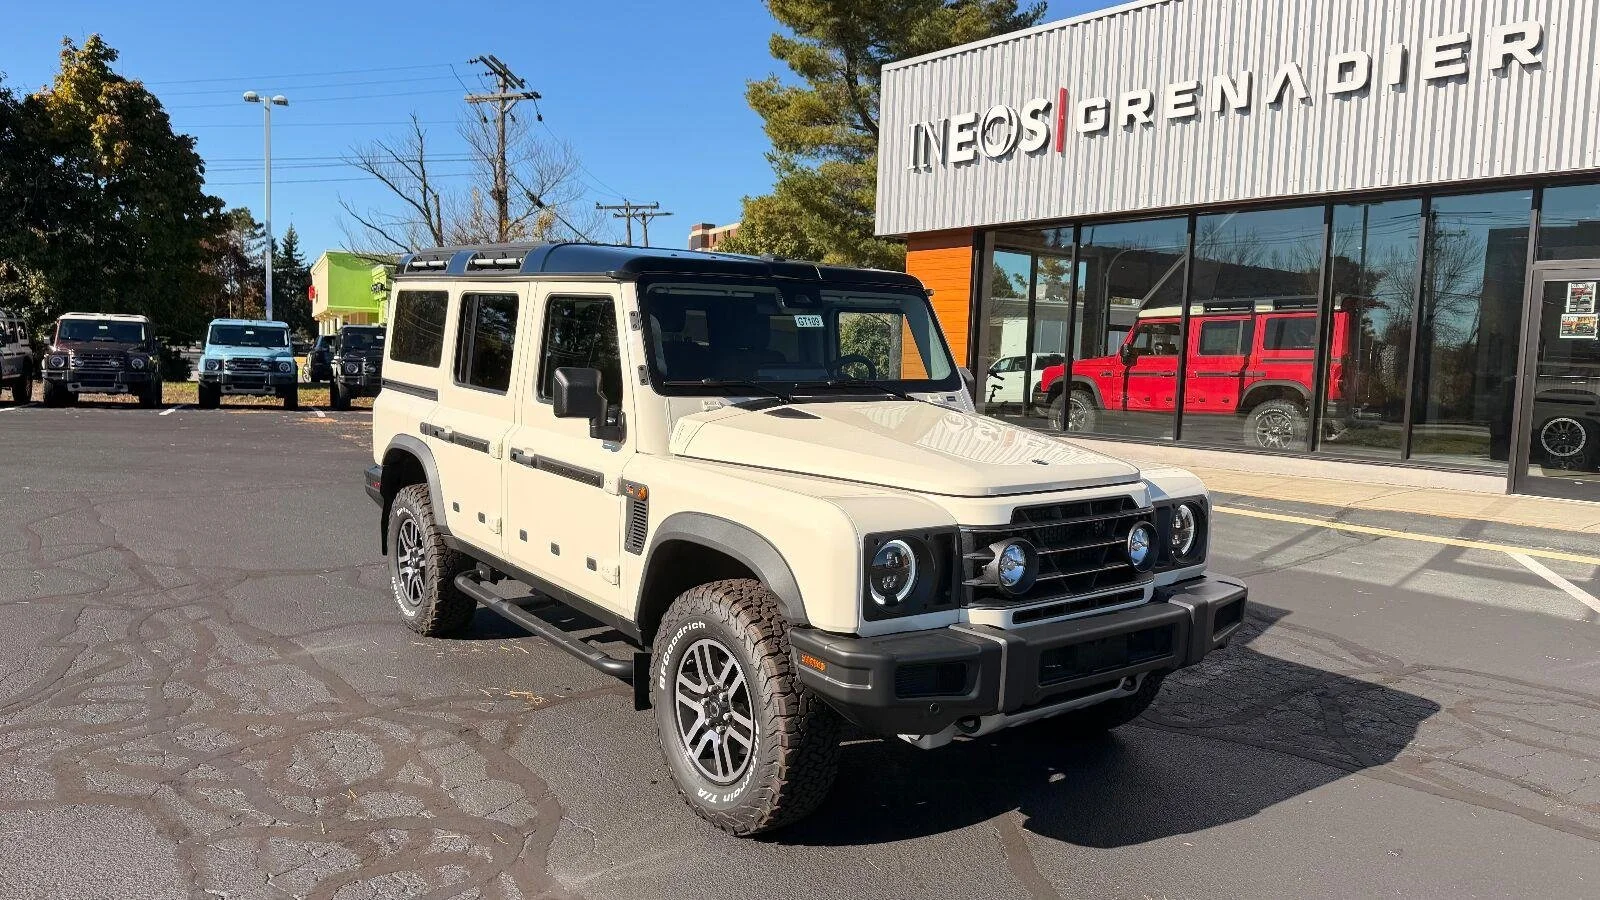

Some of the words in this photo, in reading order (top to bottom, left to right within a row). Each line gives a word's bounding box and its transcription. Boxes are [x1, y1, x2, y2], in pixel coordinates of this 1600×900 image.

[908, 98, 1051, 170] INEOS
[1077, 21, 1543, 133] GRENADIER
[660, 621, 705, 690] BFGoodrich
